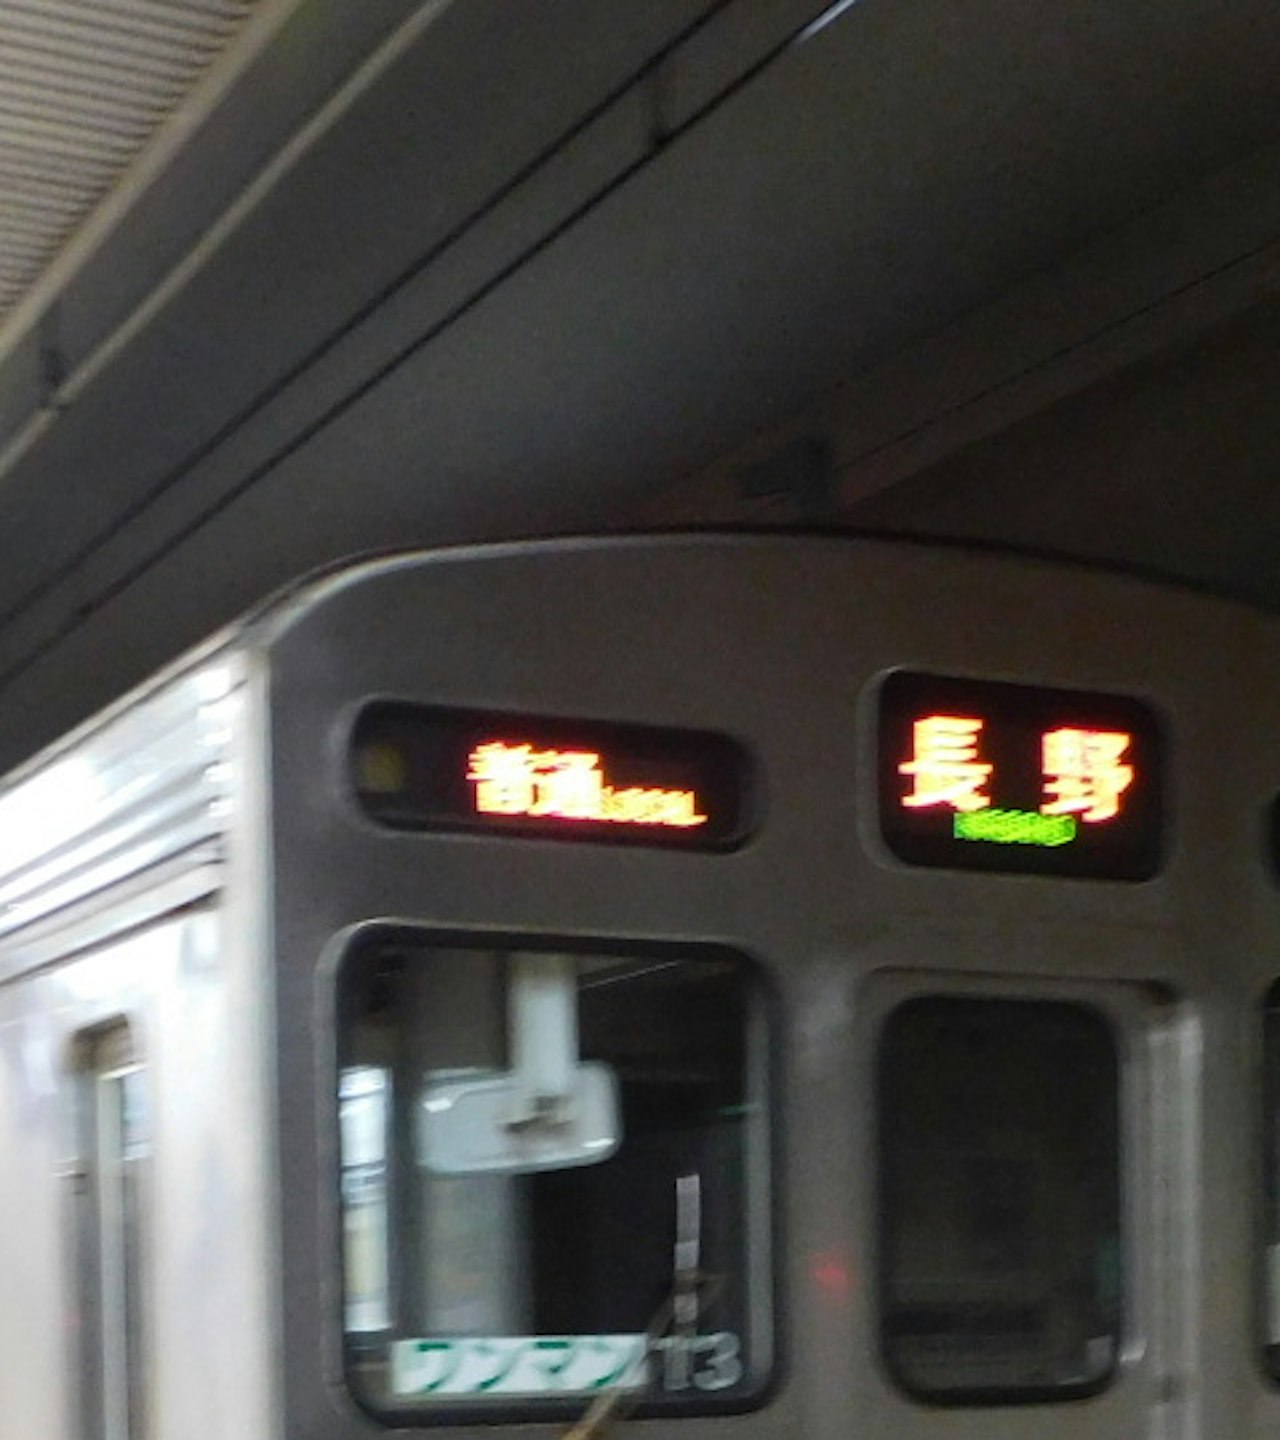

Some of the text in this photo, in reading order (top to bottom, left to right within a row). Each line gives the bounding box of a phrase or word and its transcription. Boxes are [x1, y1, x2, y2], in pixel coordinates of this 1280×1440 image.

[898, 715, 1134, 823] 長野
[408, 1338, 644, 1393] ワンマン
